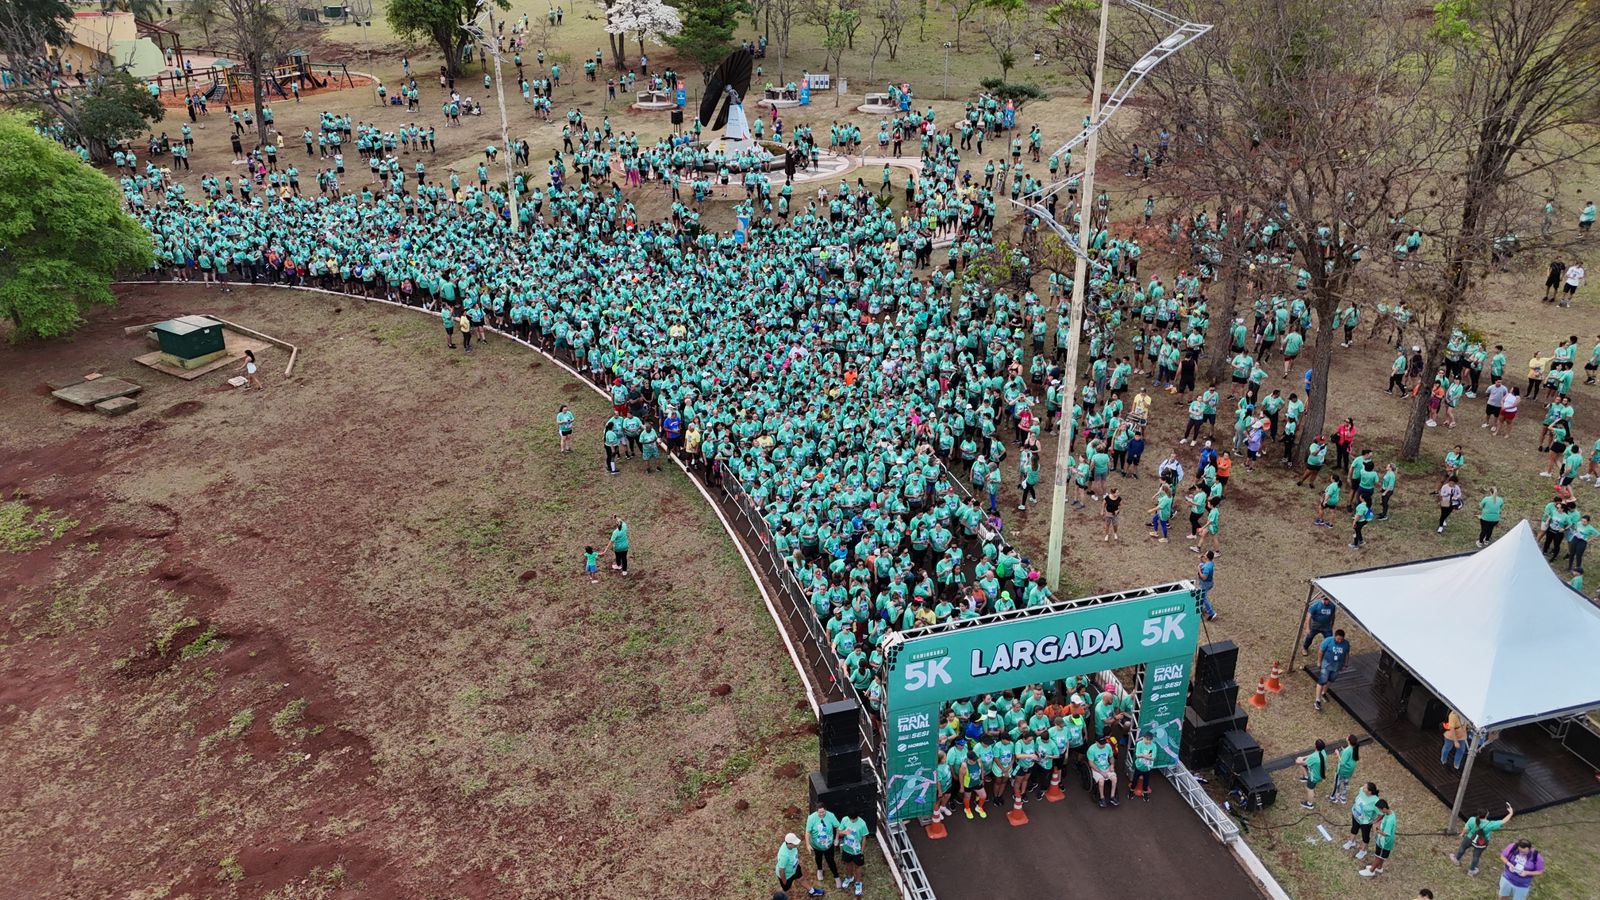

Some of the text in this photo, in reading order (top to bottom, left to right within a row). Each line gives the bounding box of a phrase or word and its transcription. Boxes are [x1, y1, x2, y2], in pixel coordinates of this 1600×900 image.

[1141, 612, 1187, 647] 5K
[971, 623, 1123, 678] LARGADA
[904, 656, 953, 692] 5K
[1164, 681, 1182, 689] SESI
[911, 730, 930, 739] SESI
